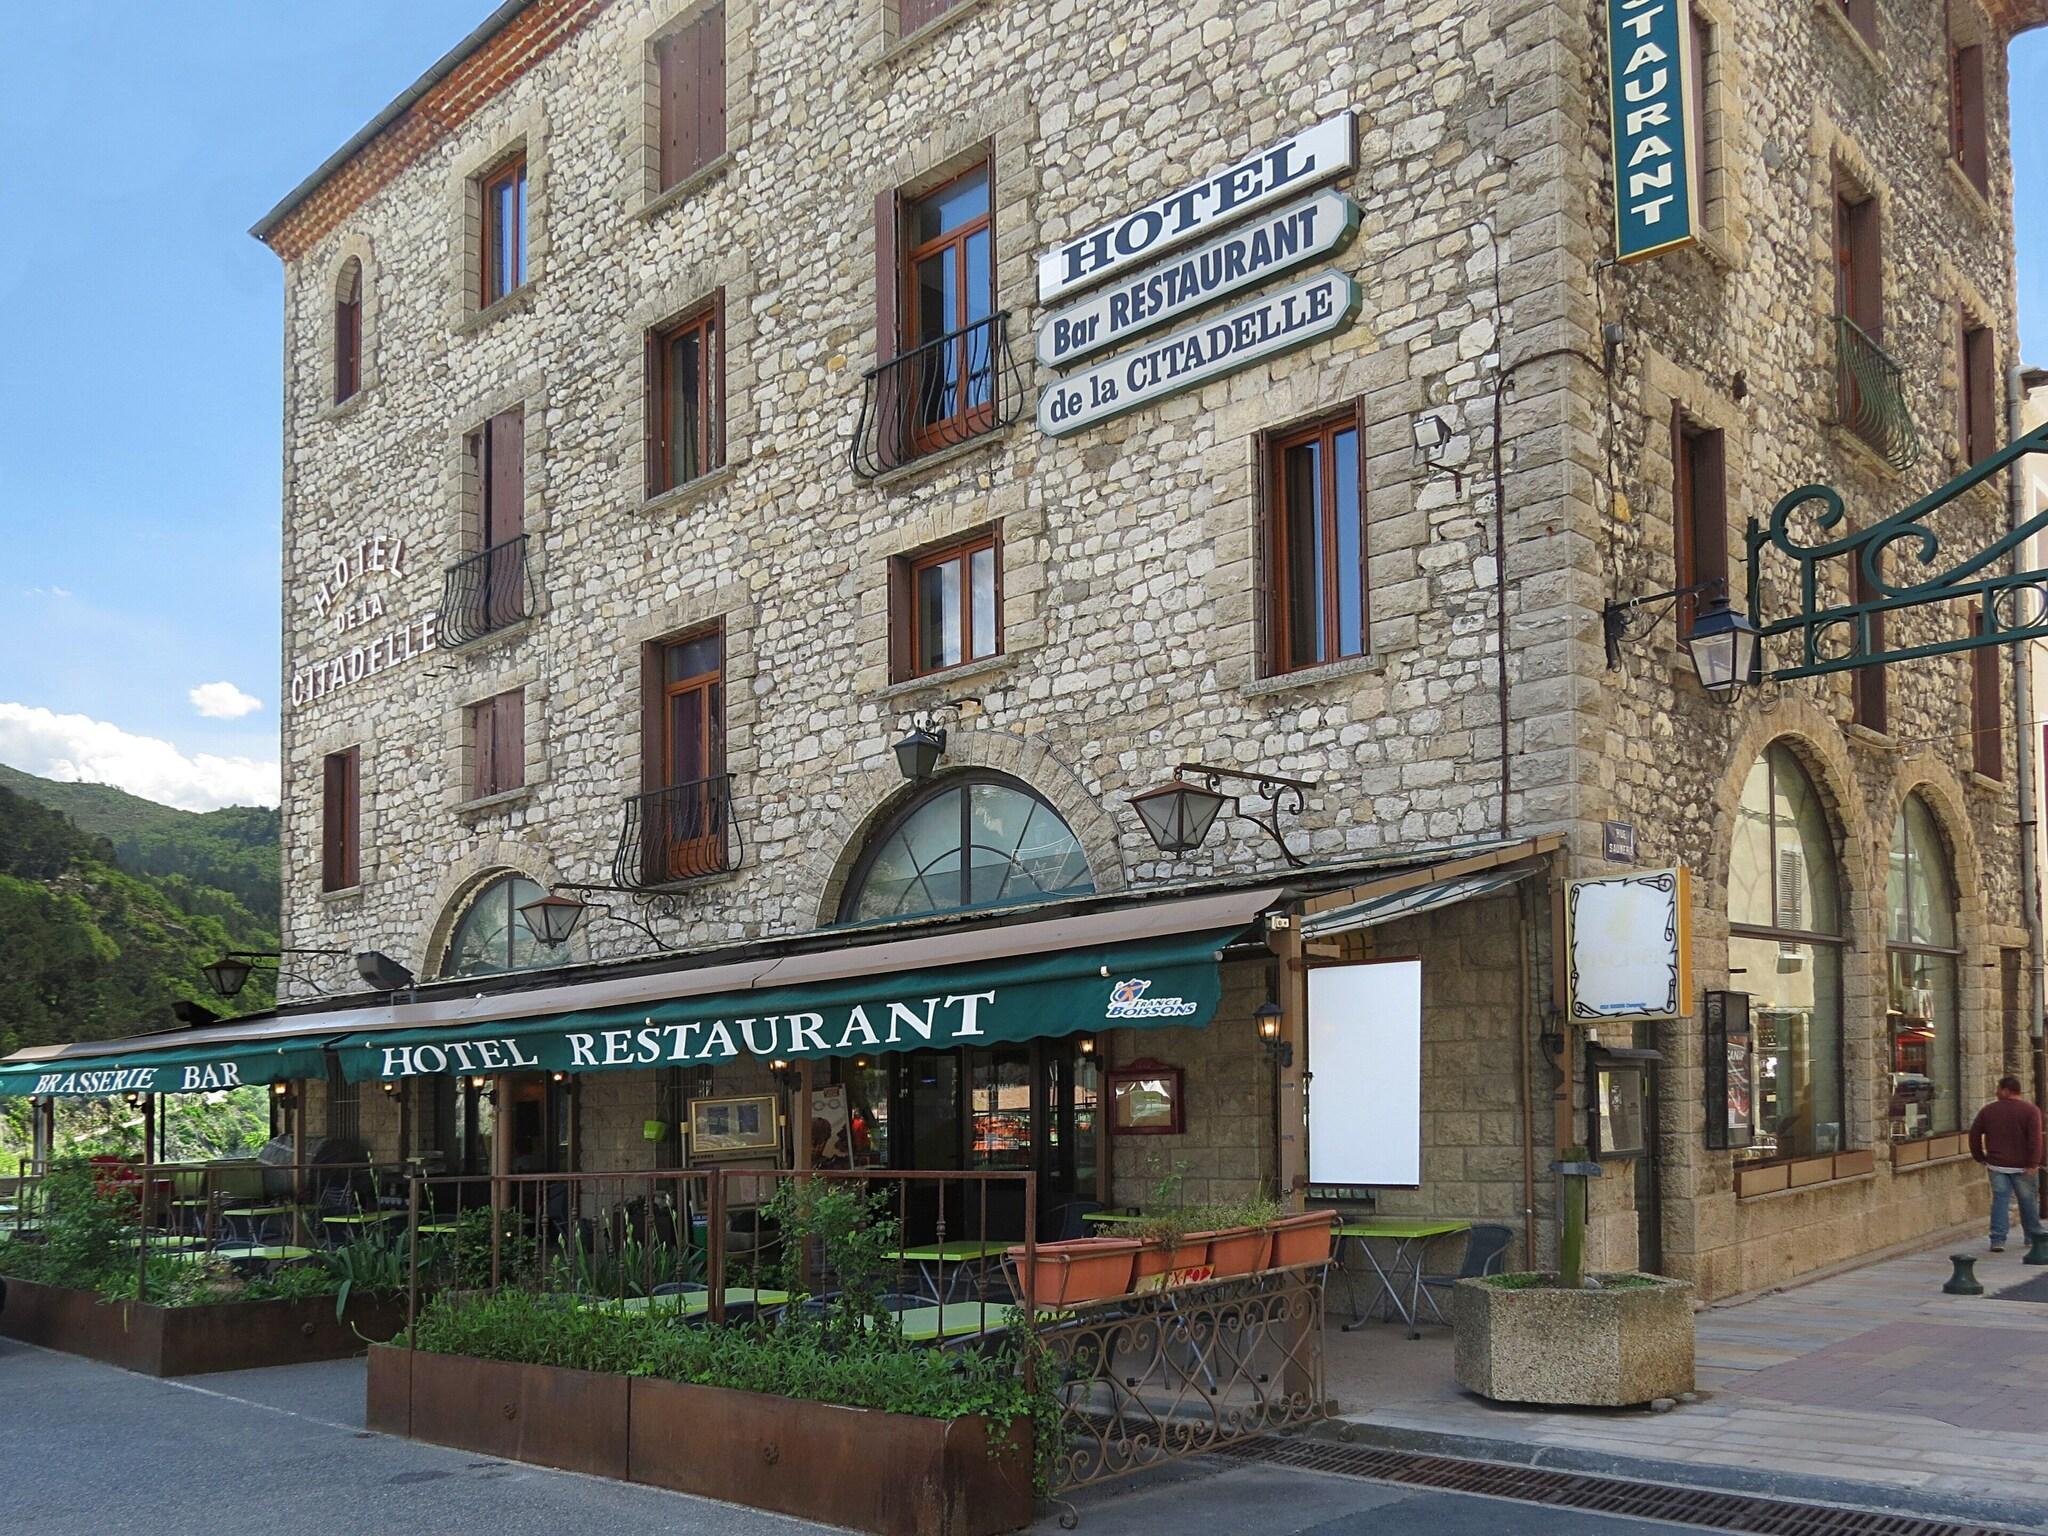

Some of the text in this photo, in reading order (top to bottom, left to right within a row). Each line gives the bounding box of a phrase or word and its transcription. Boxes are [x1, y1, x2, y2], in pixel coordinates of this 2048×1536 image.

[1620, 0, 1674, 225] TAURANT
[1062, 142, 1316, 285] HOTEL
[1054, 205, 1318, 357] Bar RESTAURANT
[1050, 281, 1333, 423] de la CITADELLE
[313, 535, 404, 618] HOTEL
[336, 593, 384, 635] DE LA
[291, 613, 437, 707] CITADELLE
[1615, 828, 1627, 840] RUE
[382, 990, 997, 1077] HOTEL RESTAURANT
[1109, 1003, 1195, 1016] BOISSONS
[1134, 998, 1181, 1008] FRANCE
[32, 1062, 244, 1094] BRASSERIE BAR
